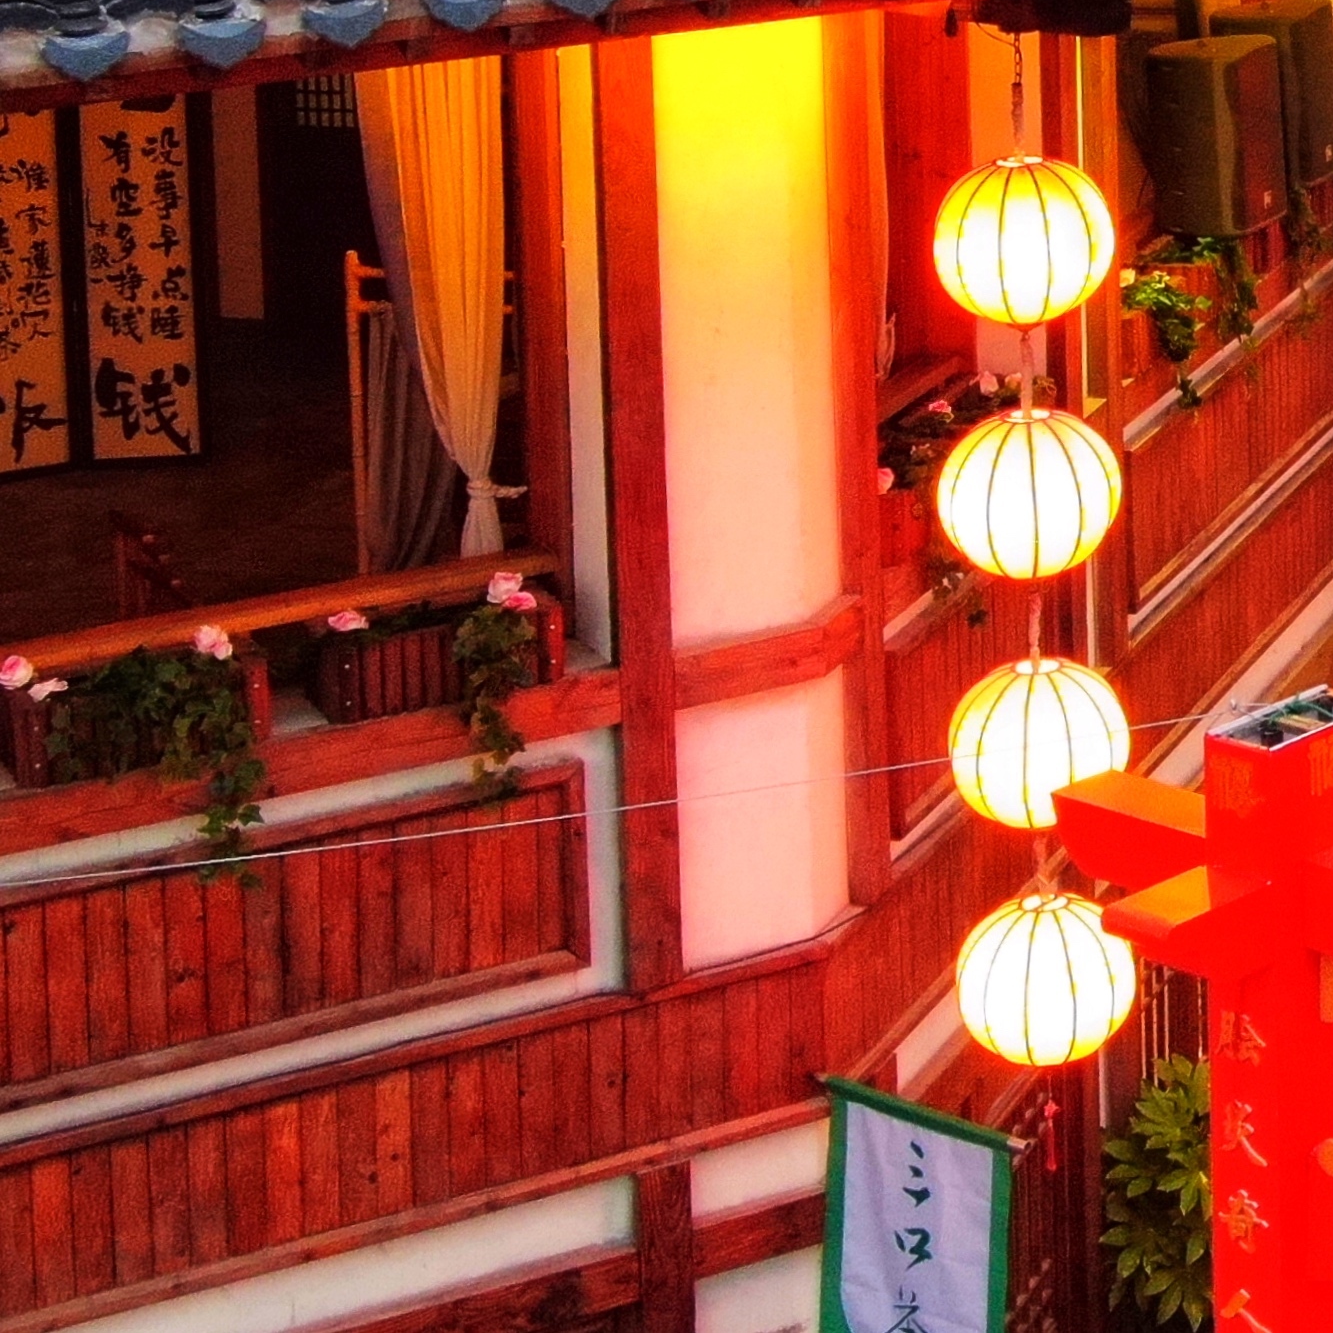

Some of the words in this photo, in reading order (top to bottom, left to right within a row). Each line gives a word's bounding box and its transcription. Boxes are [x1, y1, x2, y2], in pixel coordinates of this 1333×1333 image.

[98, 130, 148, 345] 有空多挣钱
[141, 126, 189, 340] 没事早点睡
[94, 357, 192, 455] 钱
